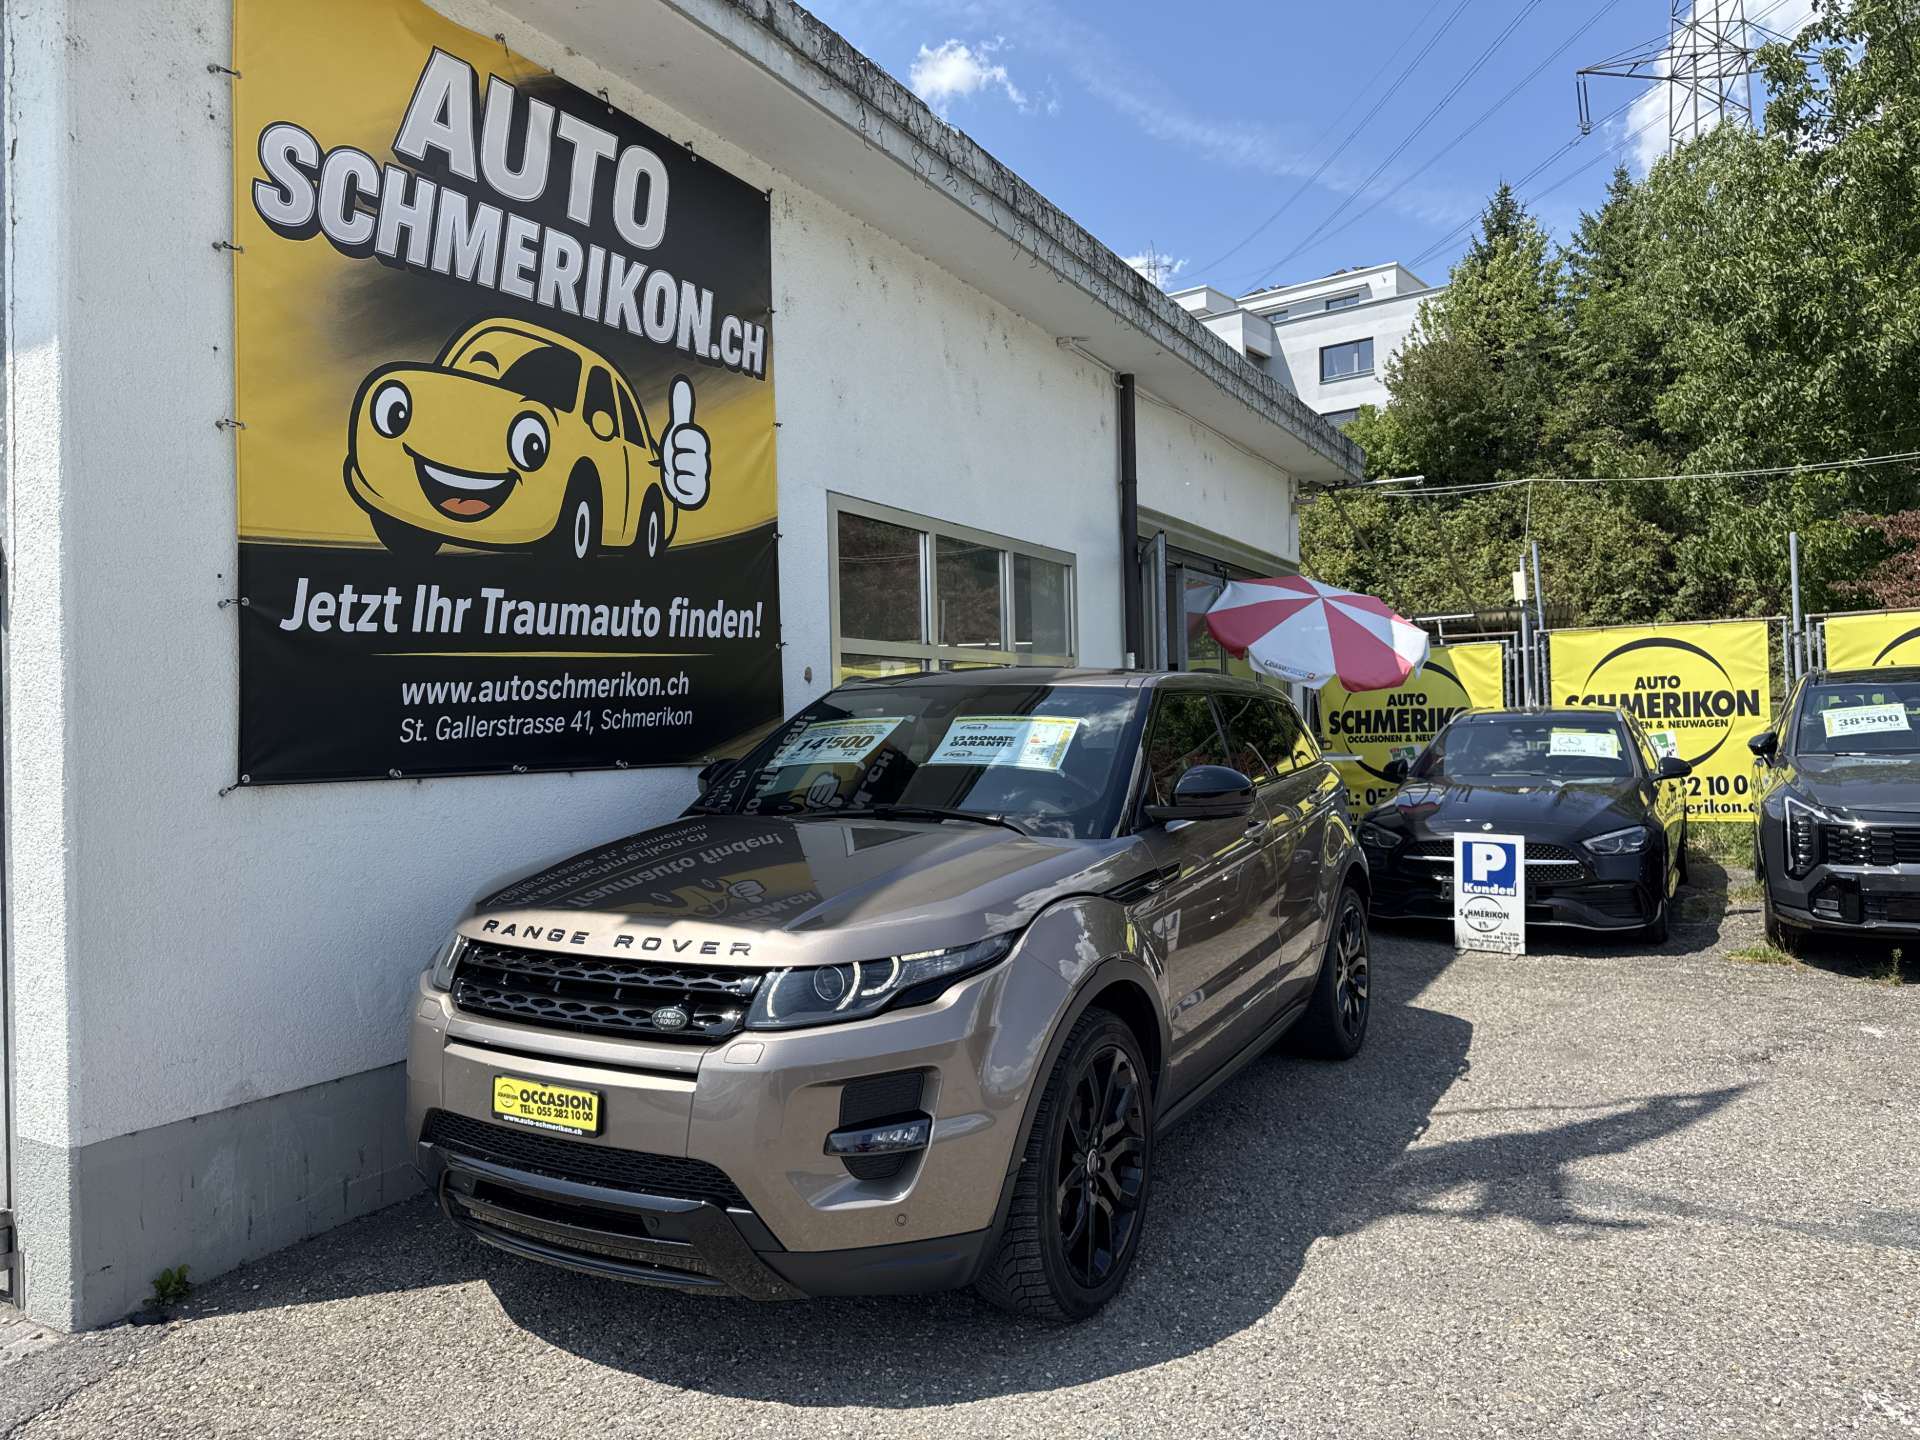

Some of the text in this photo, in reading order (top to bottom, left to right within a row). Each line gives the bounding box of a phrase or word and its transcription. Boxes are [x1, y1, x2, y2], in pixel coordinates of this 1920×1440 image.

[396, 46, 670, 250] AUTO
[253, 121, 767, 377] SCHMERIKON.CH
[279, 577, 762, 639] Jetzt Ihr Traumauto finden!
[401, 671, 689, 705] www.autoschmerikon.ch
[1634, 675, 1681, 690] AUTO
[1387, 693, 1428, 707] AUTO
[400, 707, 692, 743] St. Gallerstrasse 41, Schmerikon
[1328, 707, 1469, 735] SCHMERIK
[1668, 719, 1728, 728] NEUWAGEN
[1348, 735, 1402, 743] OCCASIONEN
[1706, 775, 1730, 796] 10
[1472, 843, 1507, 882] P
[1464, 882, 1516, 895] Kunden
[482, 919, 752, 957] RANGE ROVER
[519, 1089, 593, 1111] OCCASION
[520, 1104, 593, 1122] TEL: 055 282 10 00
